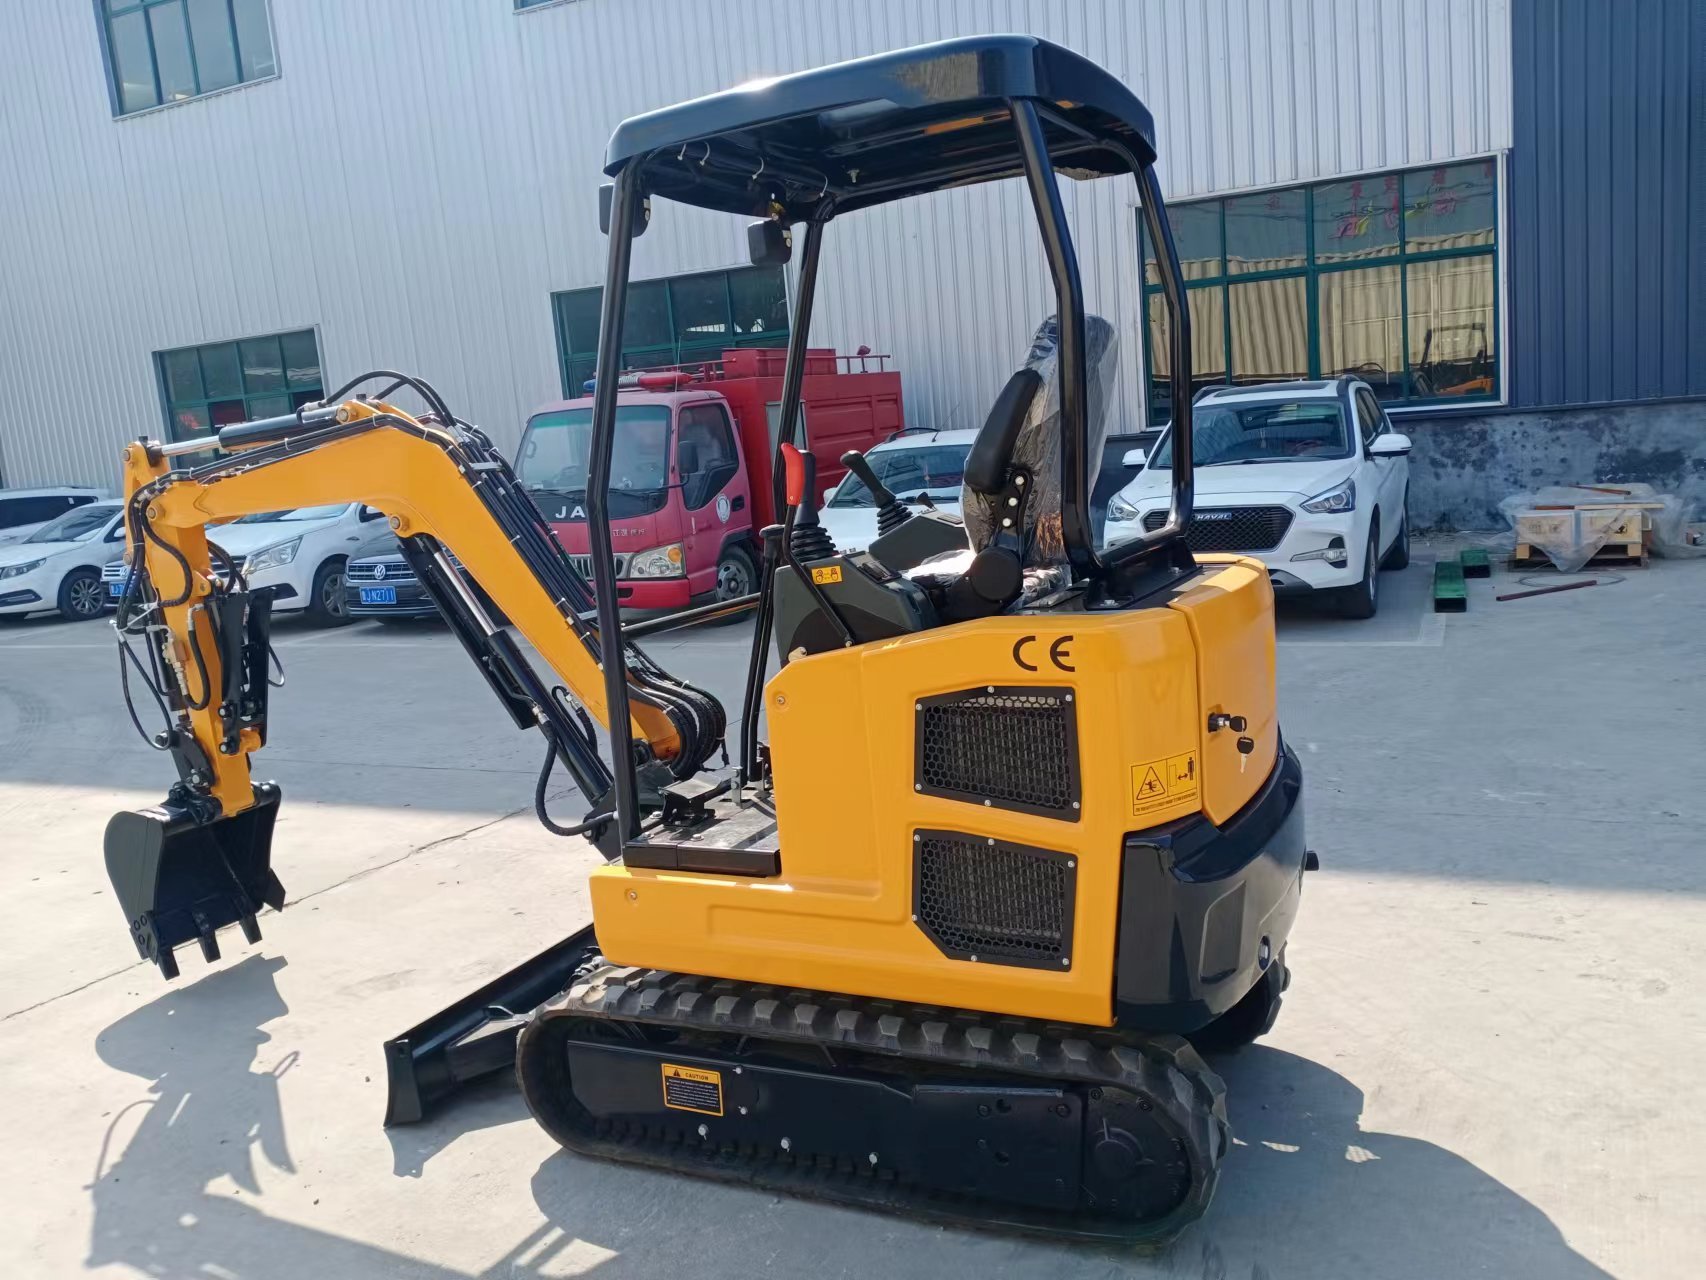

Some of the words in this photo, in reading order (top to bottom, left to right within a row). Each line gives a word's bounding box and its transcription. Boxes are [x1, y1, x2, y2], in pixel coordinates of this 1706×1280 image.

[555, 505, 586, 519] JA
[1196, 513, 1231, 521] HAVAL
[1013, 635, 1076, 673] CE
[685, 1072, 709, 1081] CAUTION
